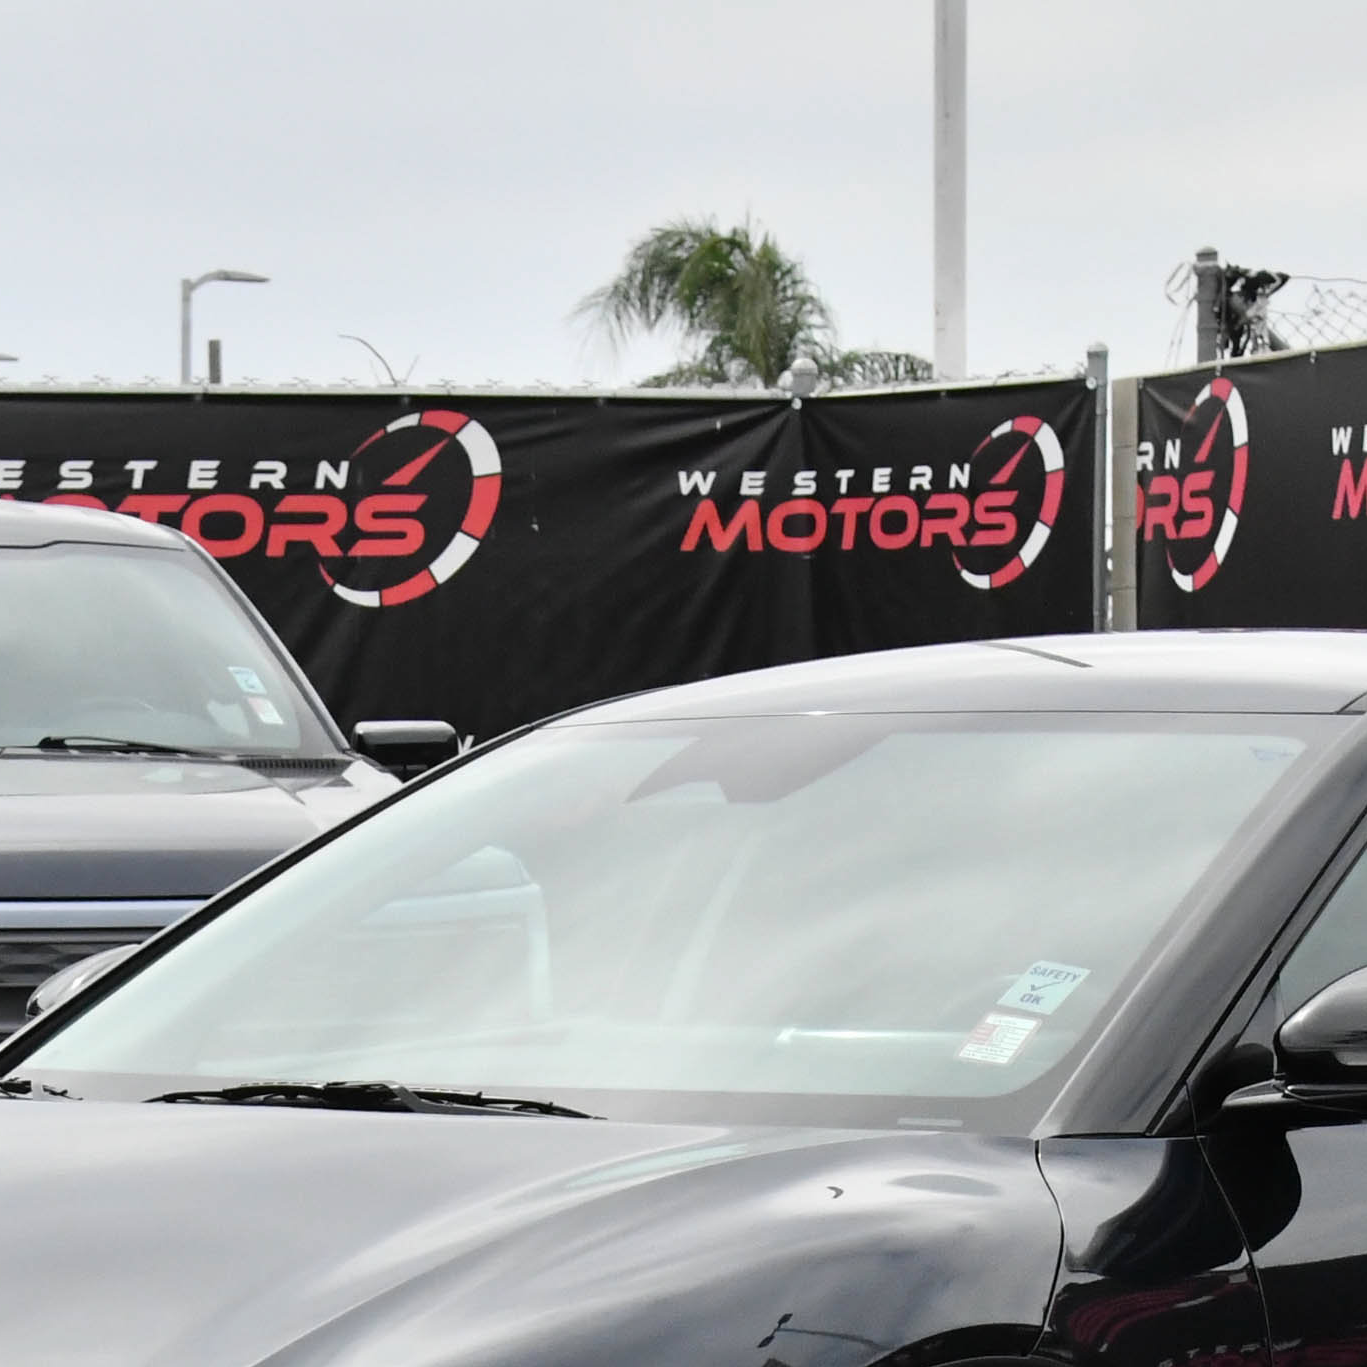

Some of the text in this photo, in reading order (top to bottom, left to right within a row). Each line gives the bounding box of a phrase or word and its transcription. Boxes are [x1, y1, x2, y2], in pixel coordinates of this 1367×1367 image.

[678, 462, 971, 496] WESTERN
[679, 490, 1019, 552] MOTORS
[1136, 470, 1216, 542] RS
[1029, 965, 1082, 983] SAFETY
[1019, 992, 1045, 1006] OK
